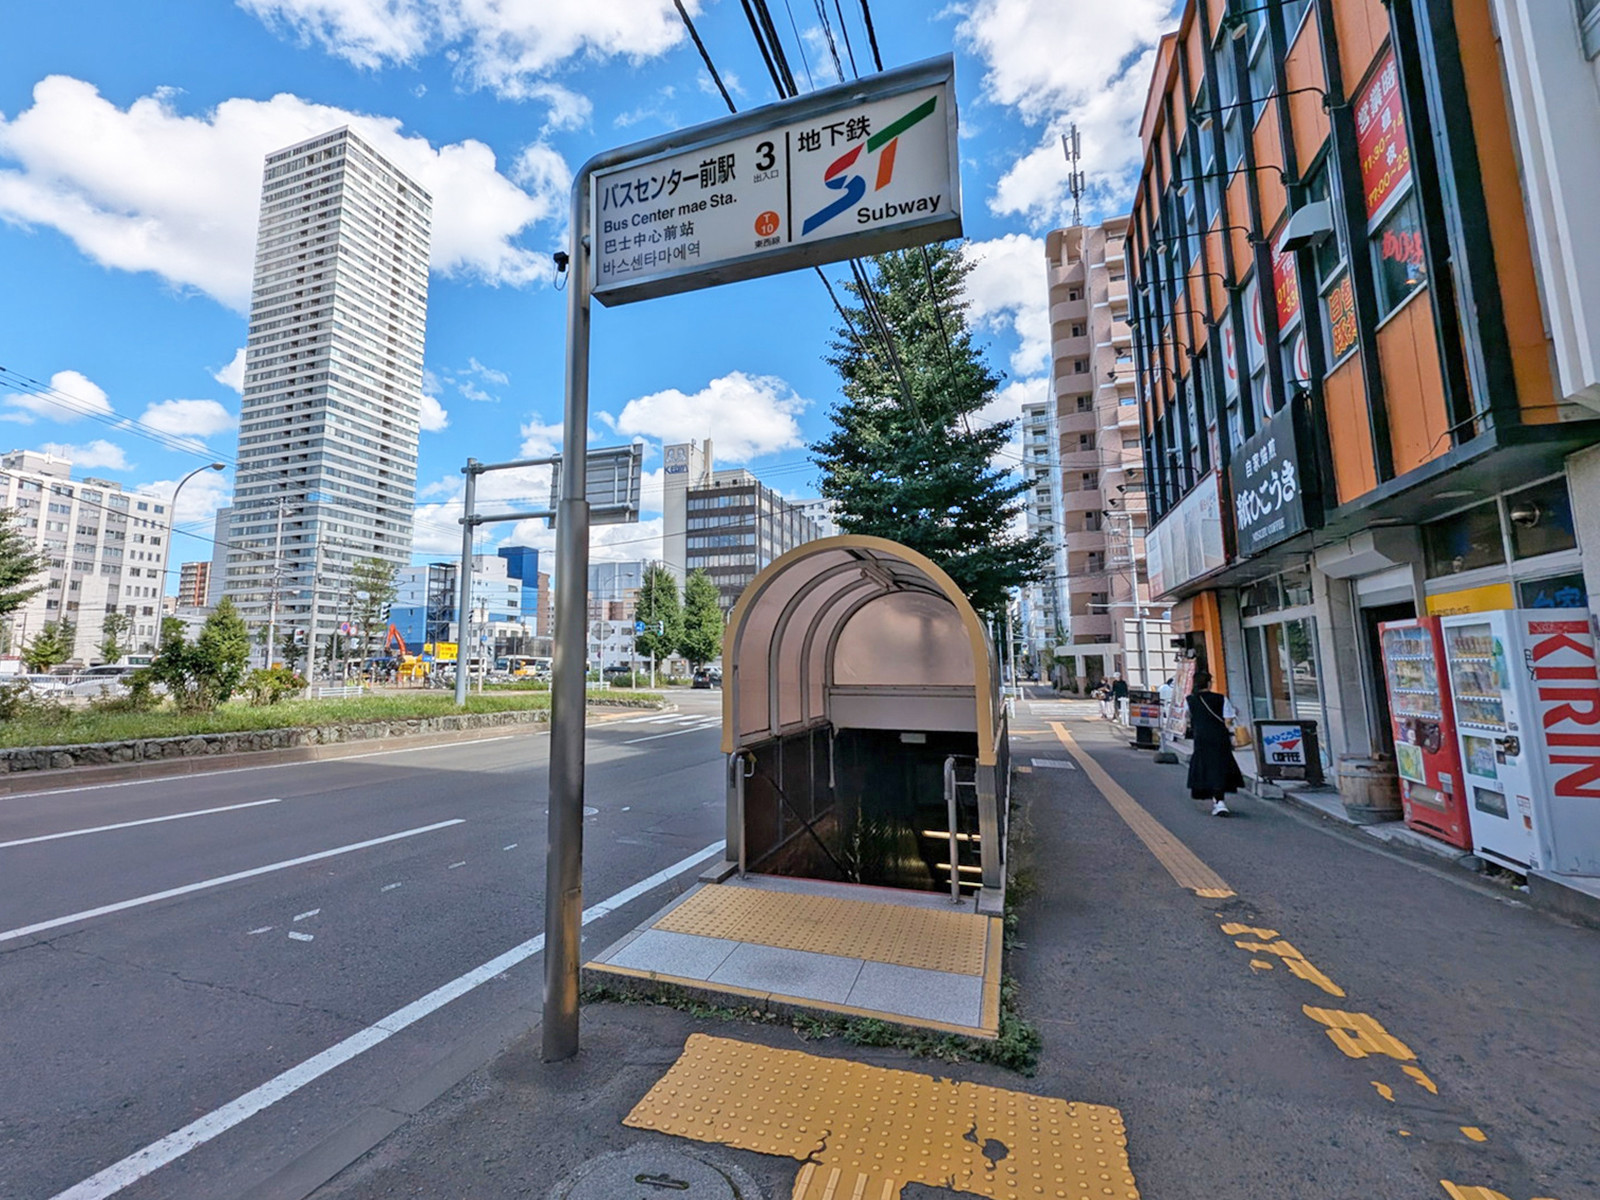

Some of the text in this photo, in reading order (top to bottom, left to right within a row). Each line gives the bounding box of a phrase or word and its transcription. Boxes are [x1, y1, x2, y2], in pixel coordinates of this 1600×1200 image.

[798, 115, 871, 152] 地下鉄
[755, 141, 776, 171] 3
[603, 153, 736, 211] バスセンター前駅
[753, 169, 779, 184] 出入口
[604, 193, 737, 234] Bus Center mae Sta.
[763, 213, 771, 224] T
[857, 194, 941, 224] Subway
[604, 221, 694, 254] 巴士中心前站
[754, 235, 781, 249] 東西線
[761, 224, 774, 234] 10
[602, 240, 700, 276] 바스센타마에역
[1236, 460, 1296, 530] 紙ひこうき
[1528, 620, 1600, 798] KIRIN
